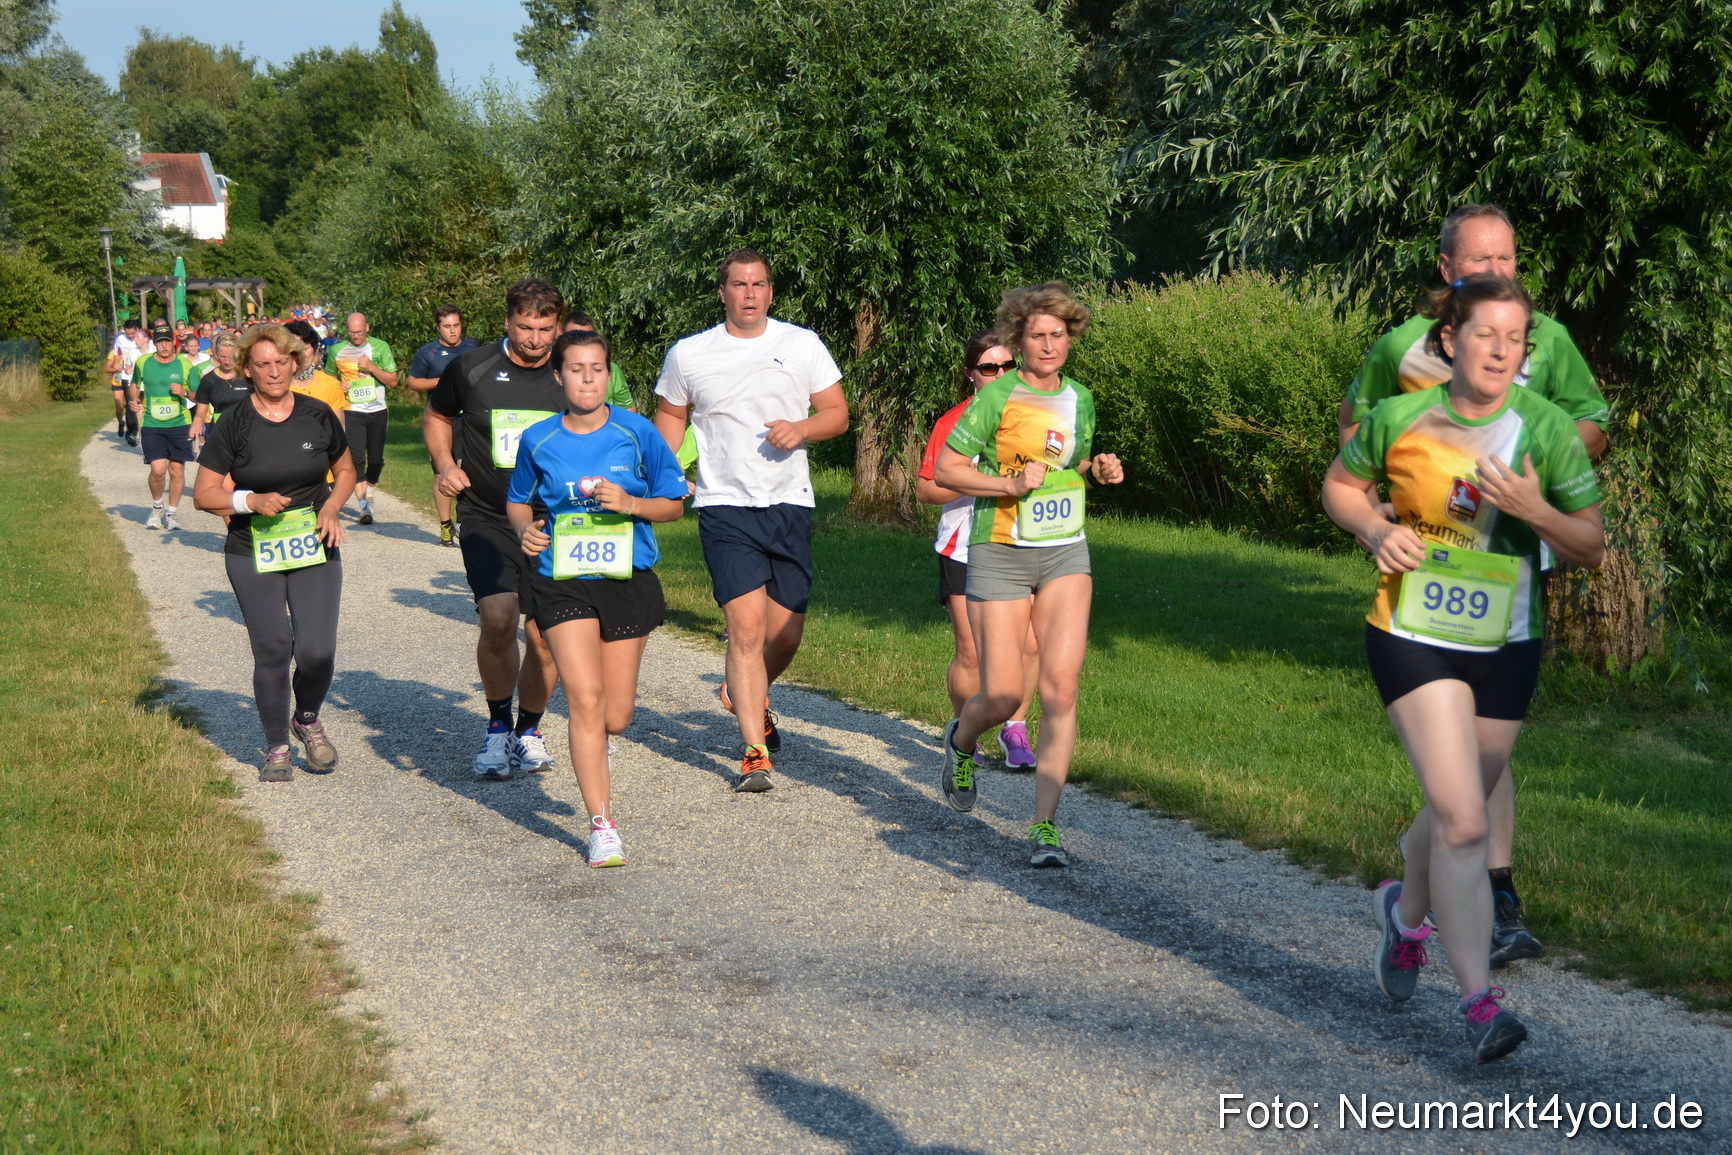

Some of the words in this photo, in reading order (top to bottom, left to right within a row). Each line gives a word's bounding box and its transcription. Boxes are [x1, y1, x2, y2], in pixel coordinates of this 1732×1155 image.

[353, 388, 371, 397] 986
[159, 406, 171, 415] 20
[565, 481, 578, 500] I
[1032, 497, 1072, 523] 990
[259, 534, 320, 564] 5189
[569, 541, 616, 563] 488
[1423, 581, 1489, 620] 989
[1429, 617, 1458, 629] Susanne
